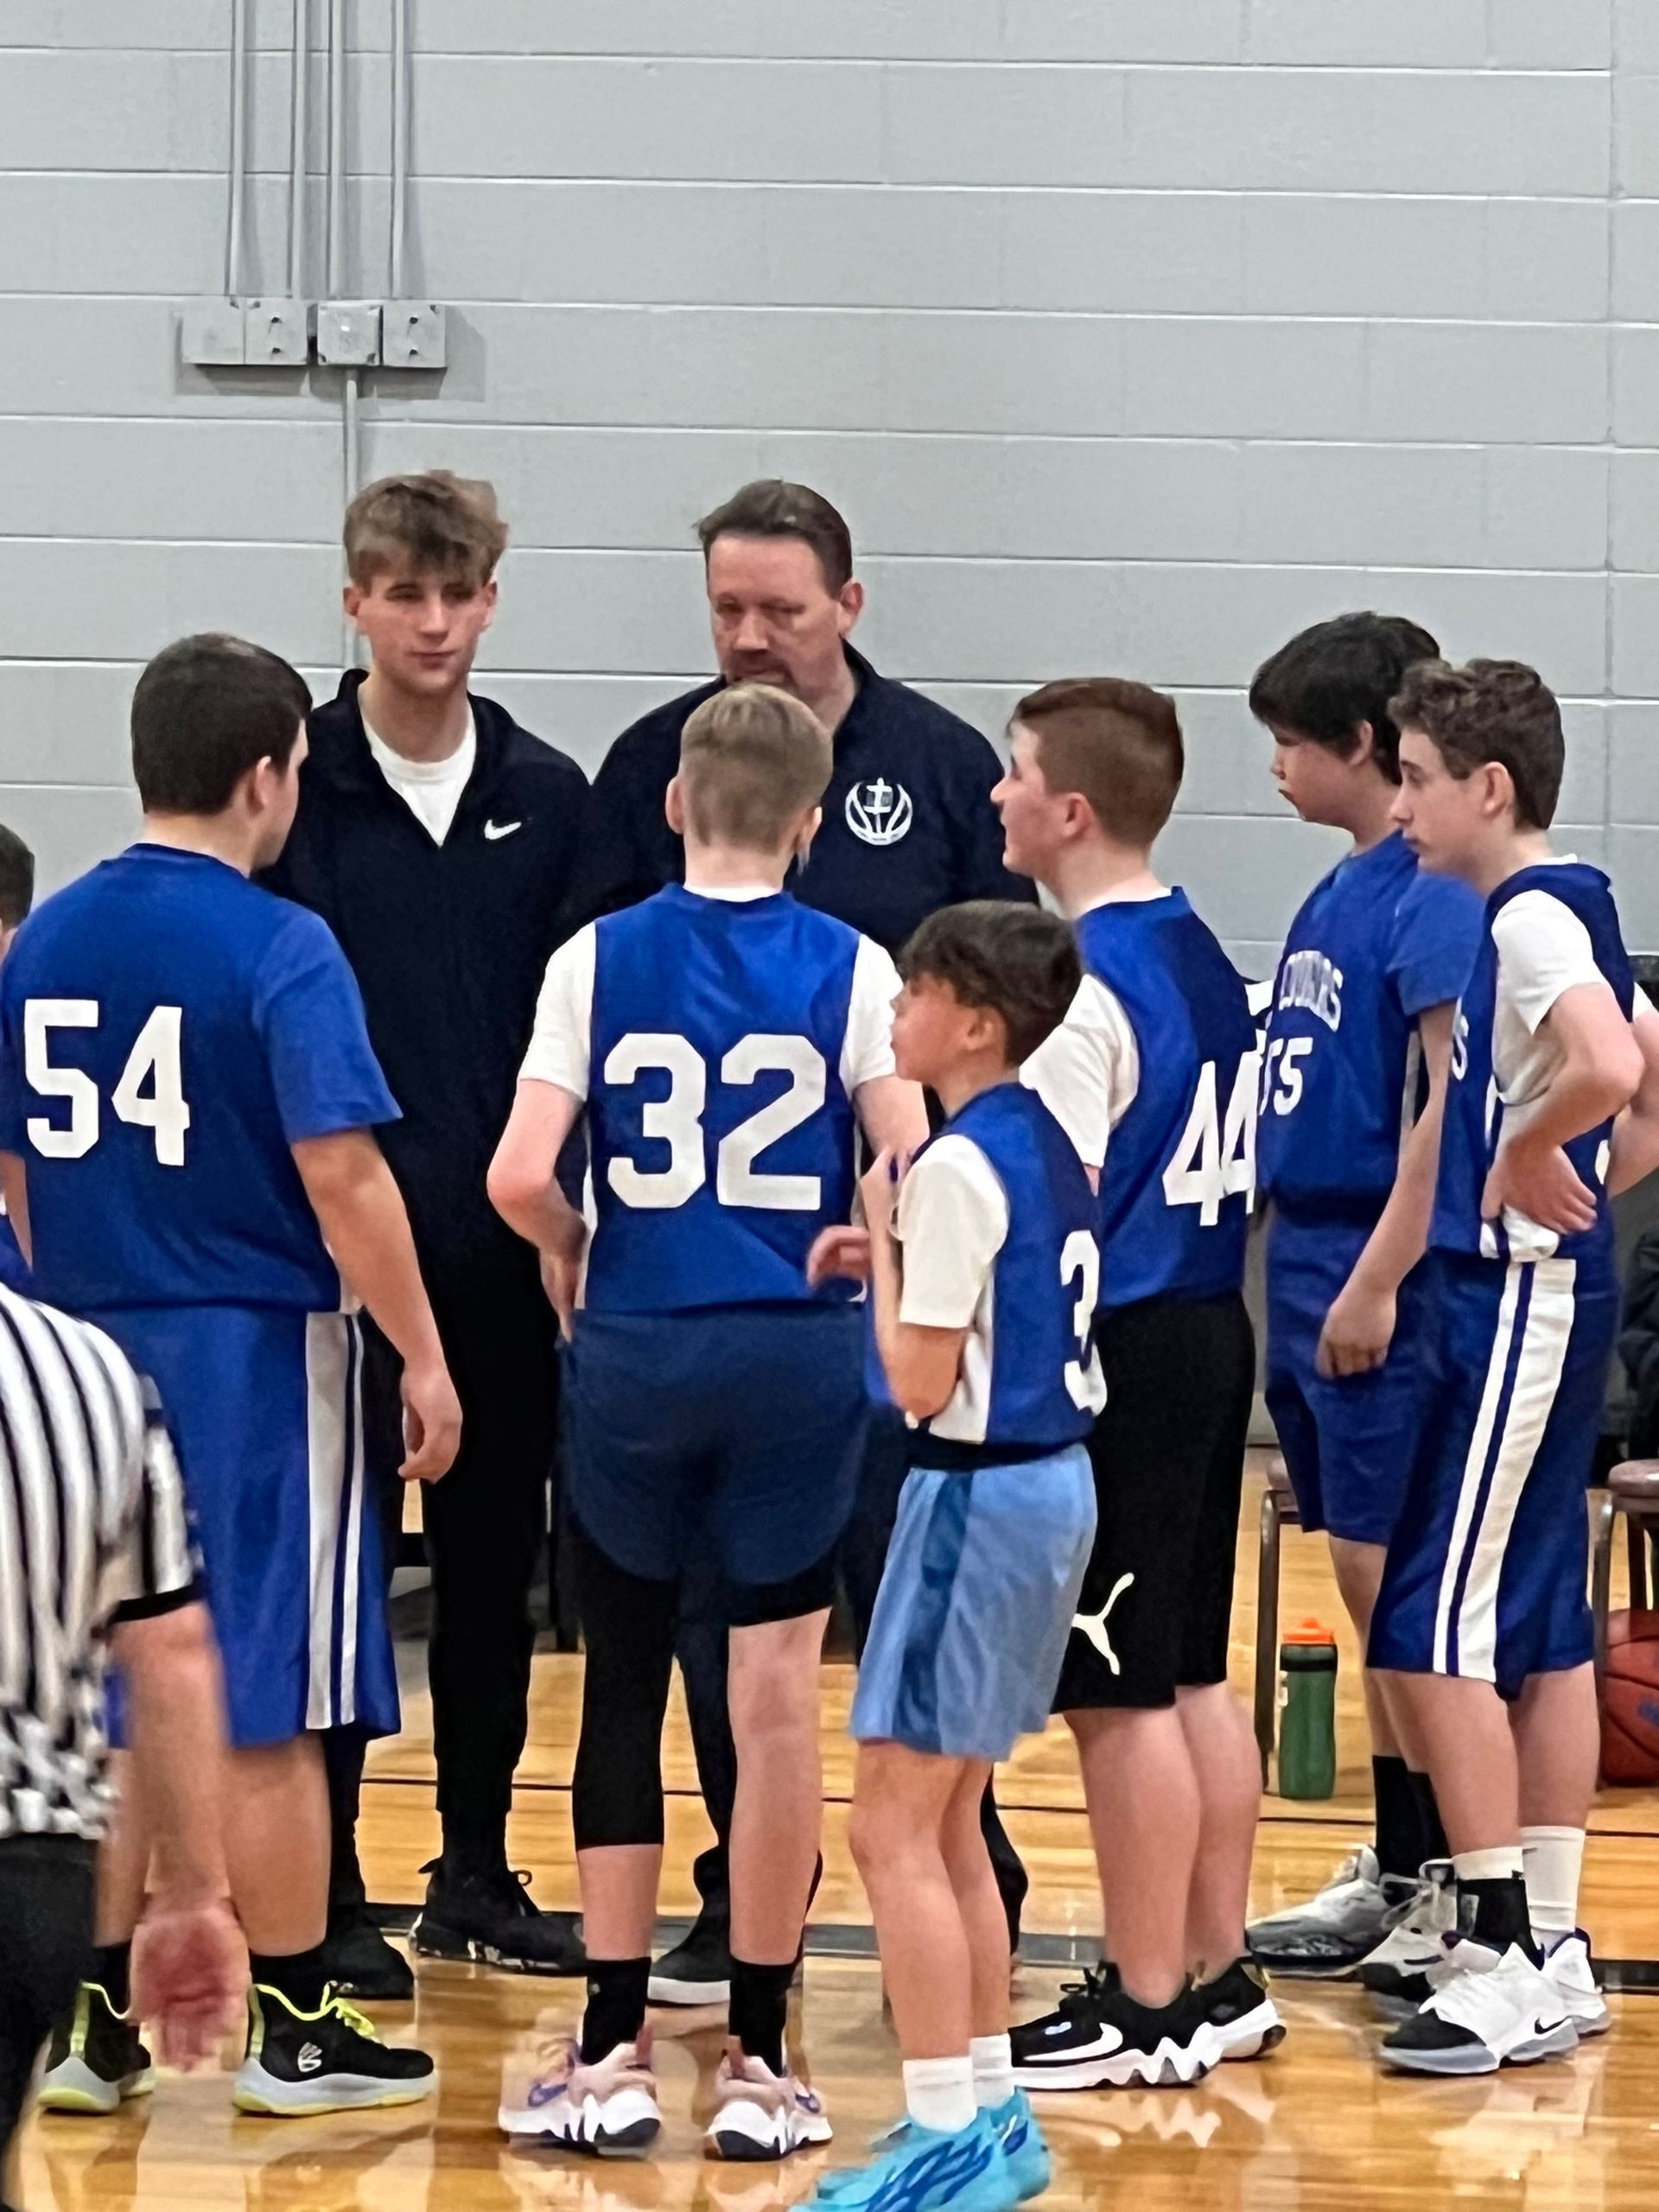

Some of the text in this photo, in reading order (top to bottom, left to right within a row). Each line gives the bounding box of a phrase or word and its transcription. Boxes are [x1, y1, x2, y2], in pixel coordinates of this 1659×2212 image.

[24, 999, 190, 1166] 54
[603, 1033, 826, 1210] 32
[1162, 1051, 1262, 1226] 44
